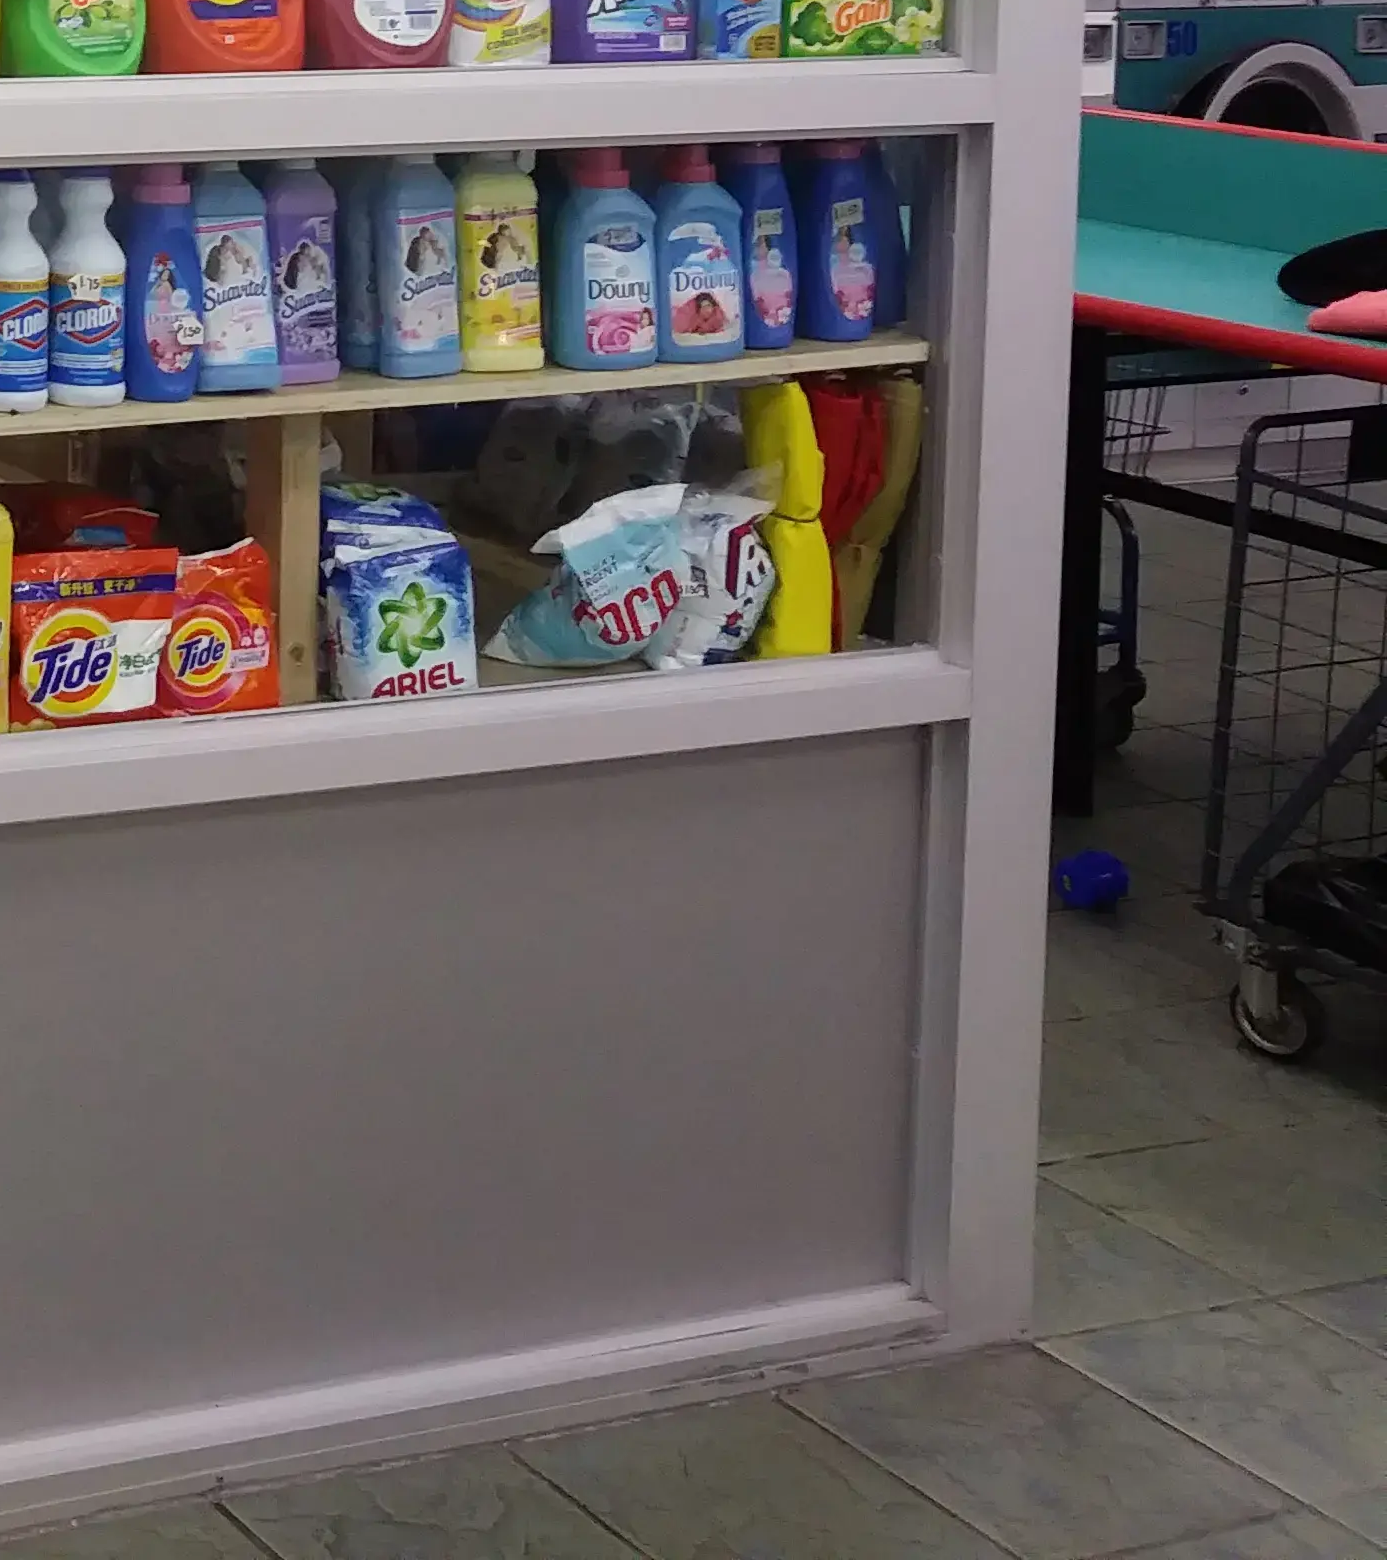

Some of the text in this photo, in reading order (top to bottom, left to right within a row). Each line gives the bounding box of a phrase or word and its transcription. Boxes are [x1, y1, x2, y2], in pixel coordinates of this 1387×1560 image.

[1166, 21, 1198, 57] 50
[202, 277, 268, 313] Suavitel
[588, 278, 650, 304] Downy
[675, 270, 737, 296] Downy
[55, 301, 121, 334] CLOROX
[30, 639, 113, 704] Tide
[175, 635, 226, 676] Tide
[370, 661, 465, 699] ARIEL
